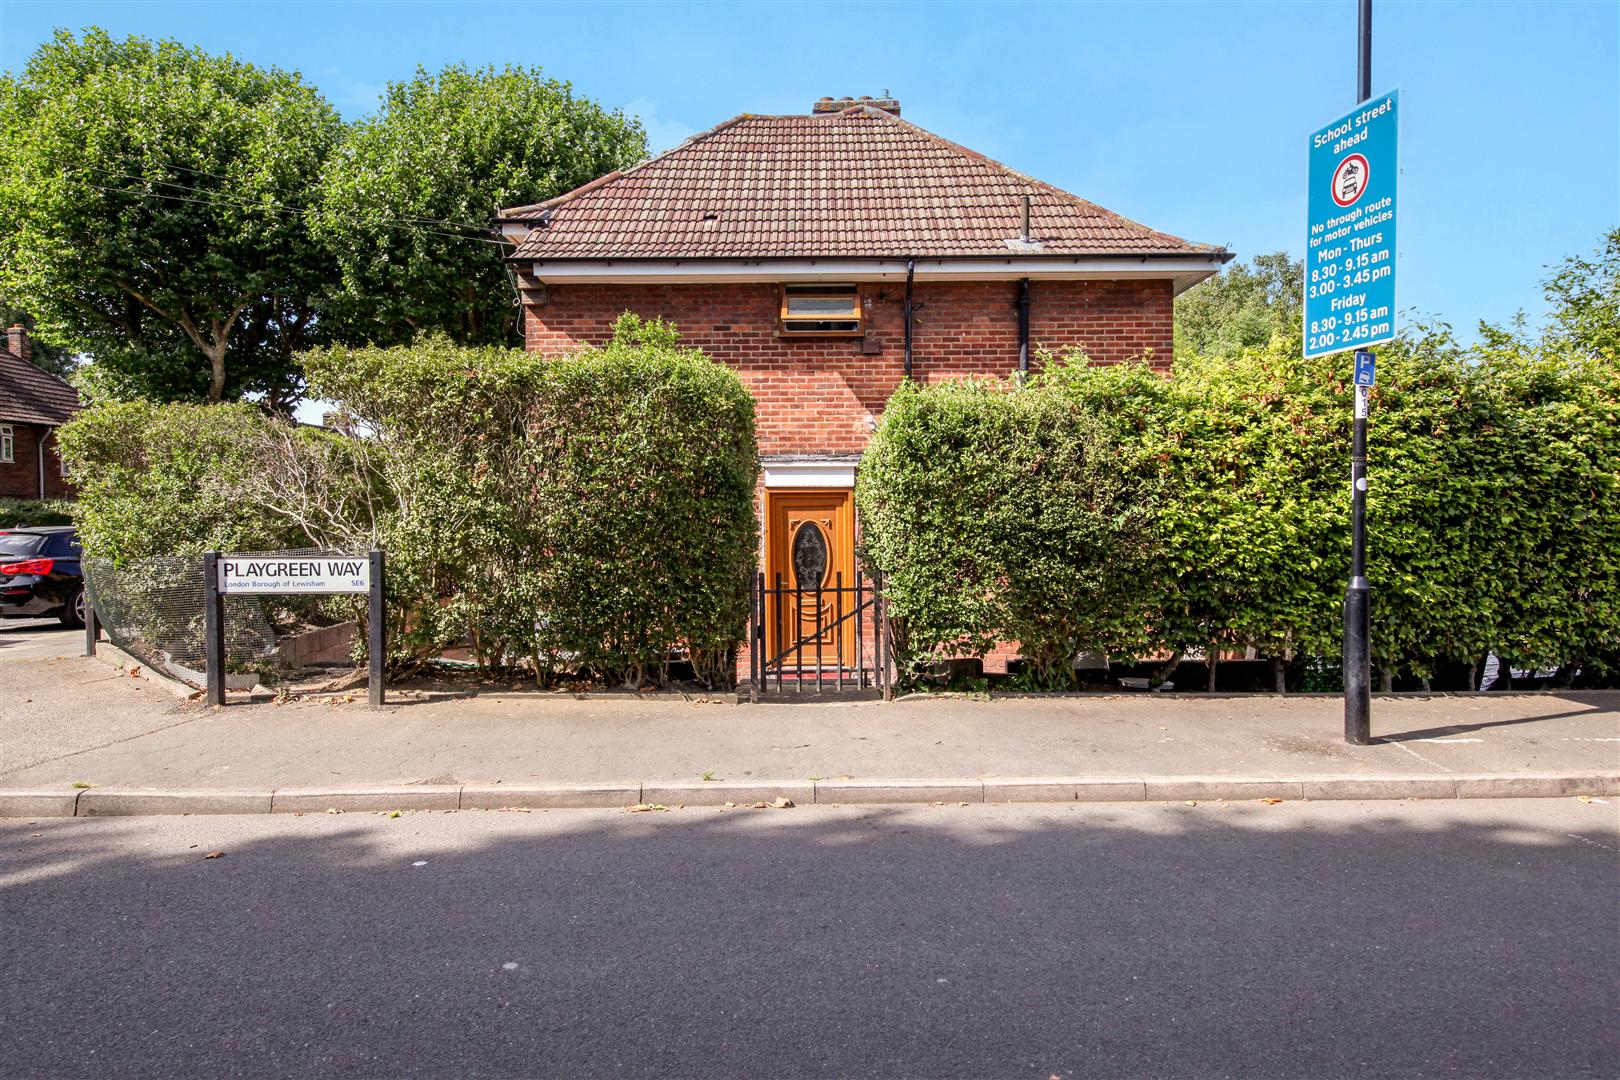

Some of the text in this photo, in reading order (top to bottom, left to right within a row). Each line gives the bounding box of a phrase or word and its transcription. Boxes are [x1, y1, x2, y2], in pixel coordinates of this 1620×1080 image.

[1314, 97, 1392, 148] School street
[1333, 126, 1368, 154] ahead
[1309, 210, 1393, 249] for motor vehicles
[1311, 197, 1392, 236] No through route
[1318, 246, 1342, 264] Mon
[1349, 232, 1383, 253] Thurs
[1311, 263, 1337, 283] 8.30
[1345, 252, 1369, 271] 9.15
[1371, 249, 1389, 263] am
[1309, 279, 1335, 299] 3.00
[1343, 268, 1370, 289] 3.45
[1372, 265, 1391, 282] pm
[1331, 292, 1366, 312] Friday
[1311, 317, 1337, 334] 8.30
[1344, 307, 1368, 326] 9.15
[1370, 305, 1388, 319] am
[1309, 332, 1335, 351] 2.00
[1342, 323, 1369, 343] 2.45
[1371, 321, 1389, 338] pm
[1360, 355, 1371, 369] P
[224, 562, 364, 577] PLAYGREEN WAY
[351, 580, 365, 588] SE6
[252, 581, 281, 589] Borough
